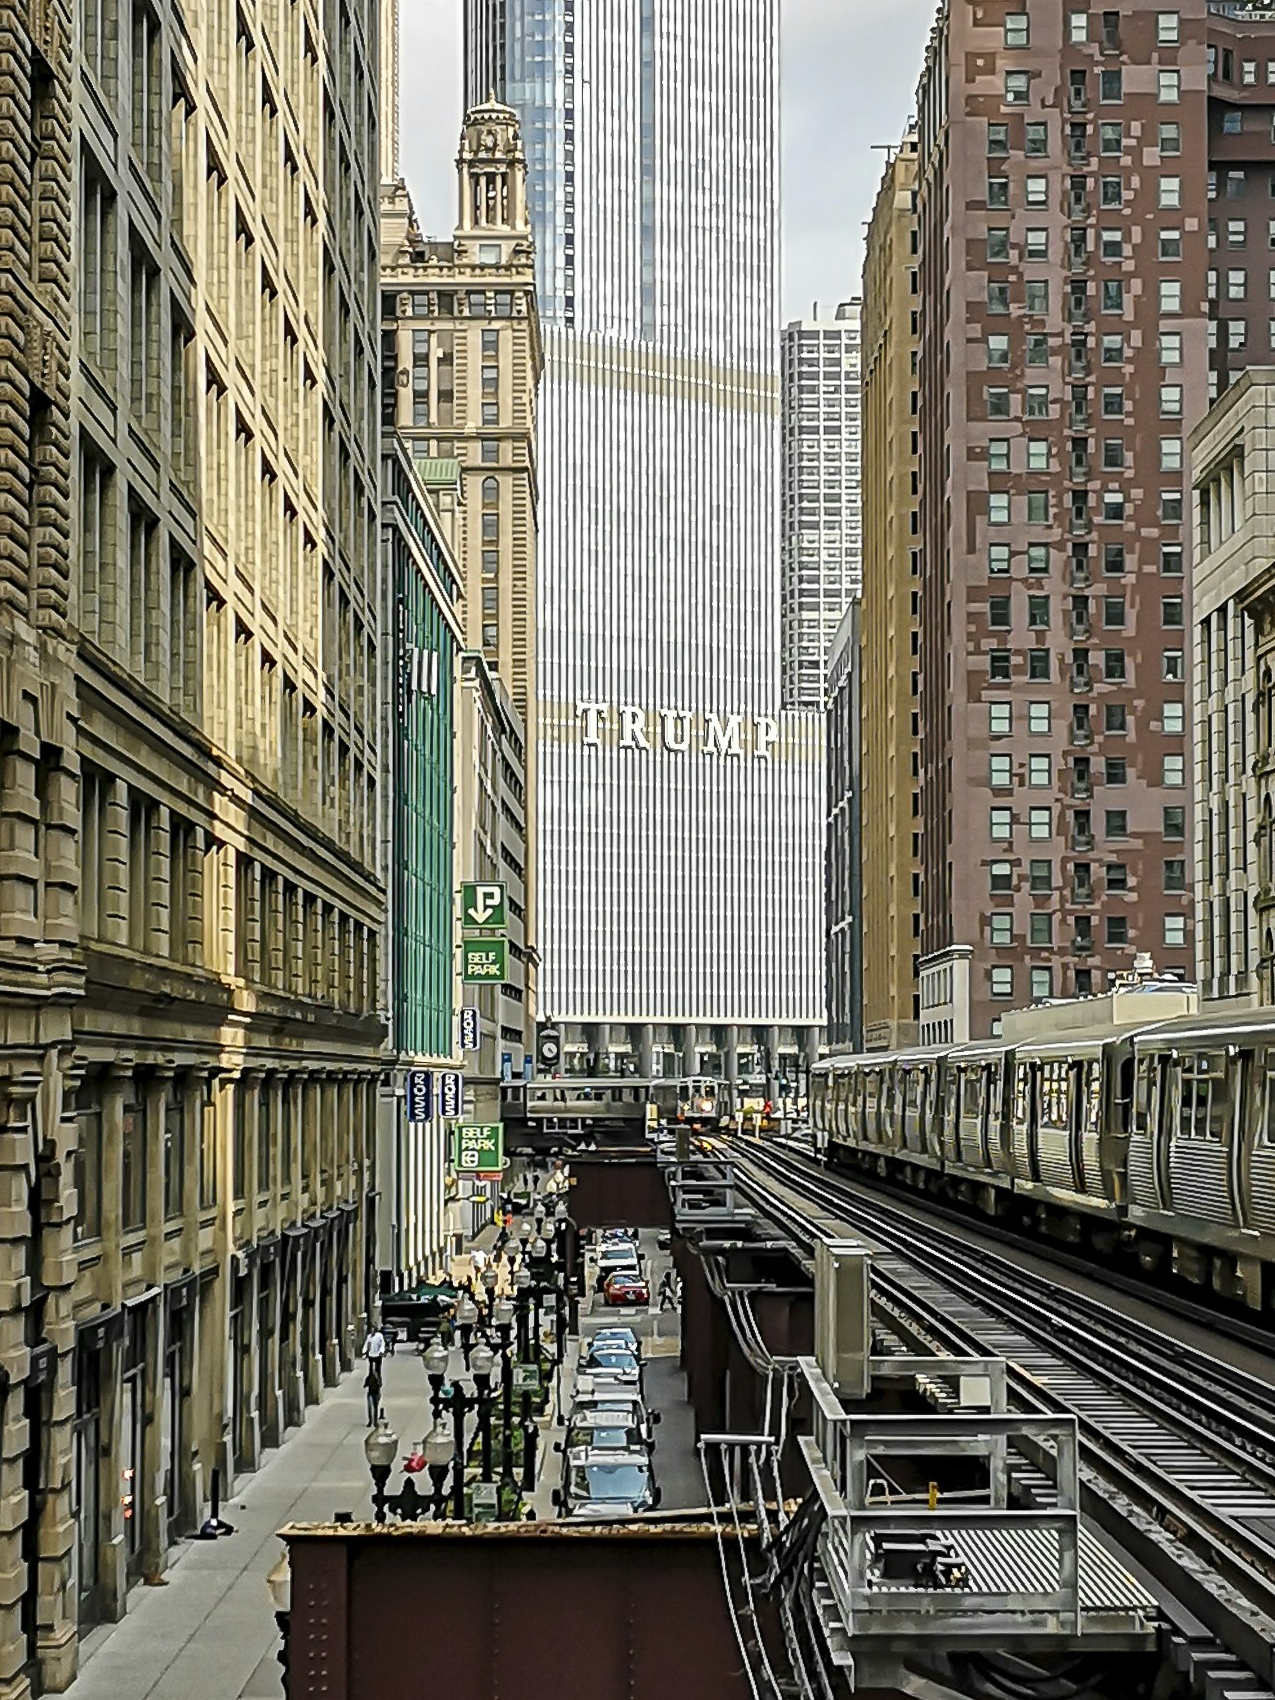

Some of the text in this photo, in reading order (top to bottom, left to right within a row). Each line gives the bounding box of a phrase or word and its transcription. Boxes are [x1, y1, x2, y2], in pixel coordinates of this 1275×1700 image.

[575, 701, 779, 757] TRUMP
[467, 952, 496, 964] SELF
[467, 964, 500, 976] PARK
[463, 1009, 474, 1049] ROSS
[413, 1073, 426, 1120] ROSS
[444, 1074, 456, 1116] ROSS
[461, 1127, 492, 1139] SELF
[461, 1139, 496, 1151] PARK
